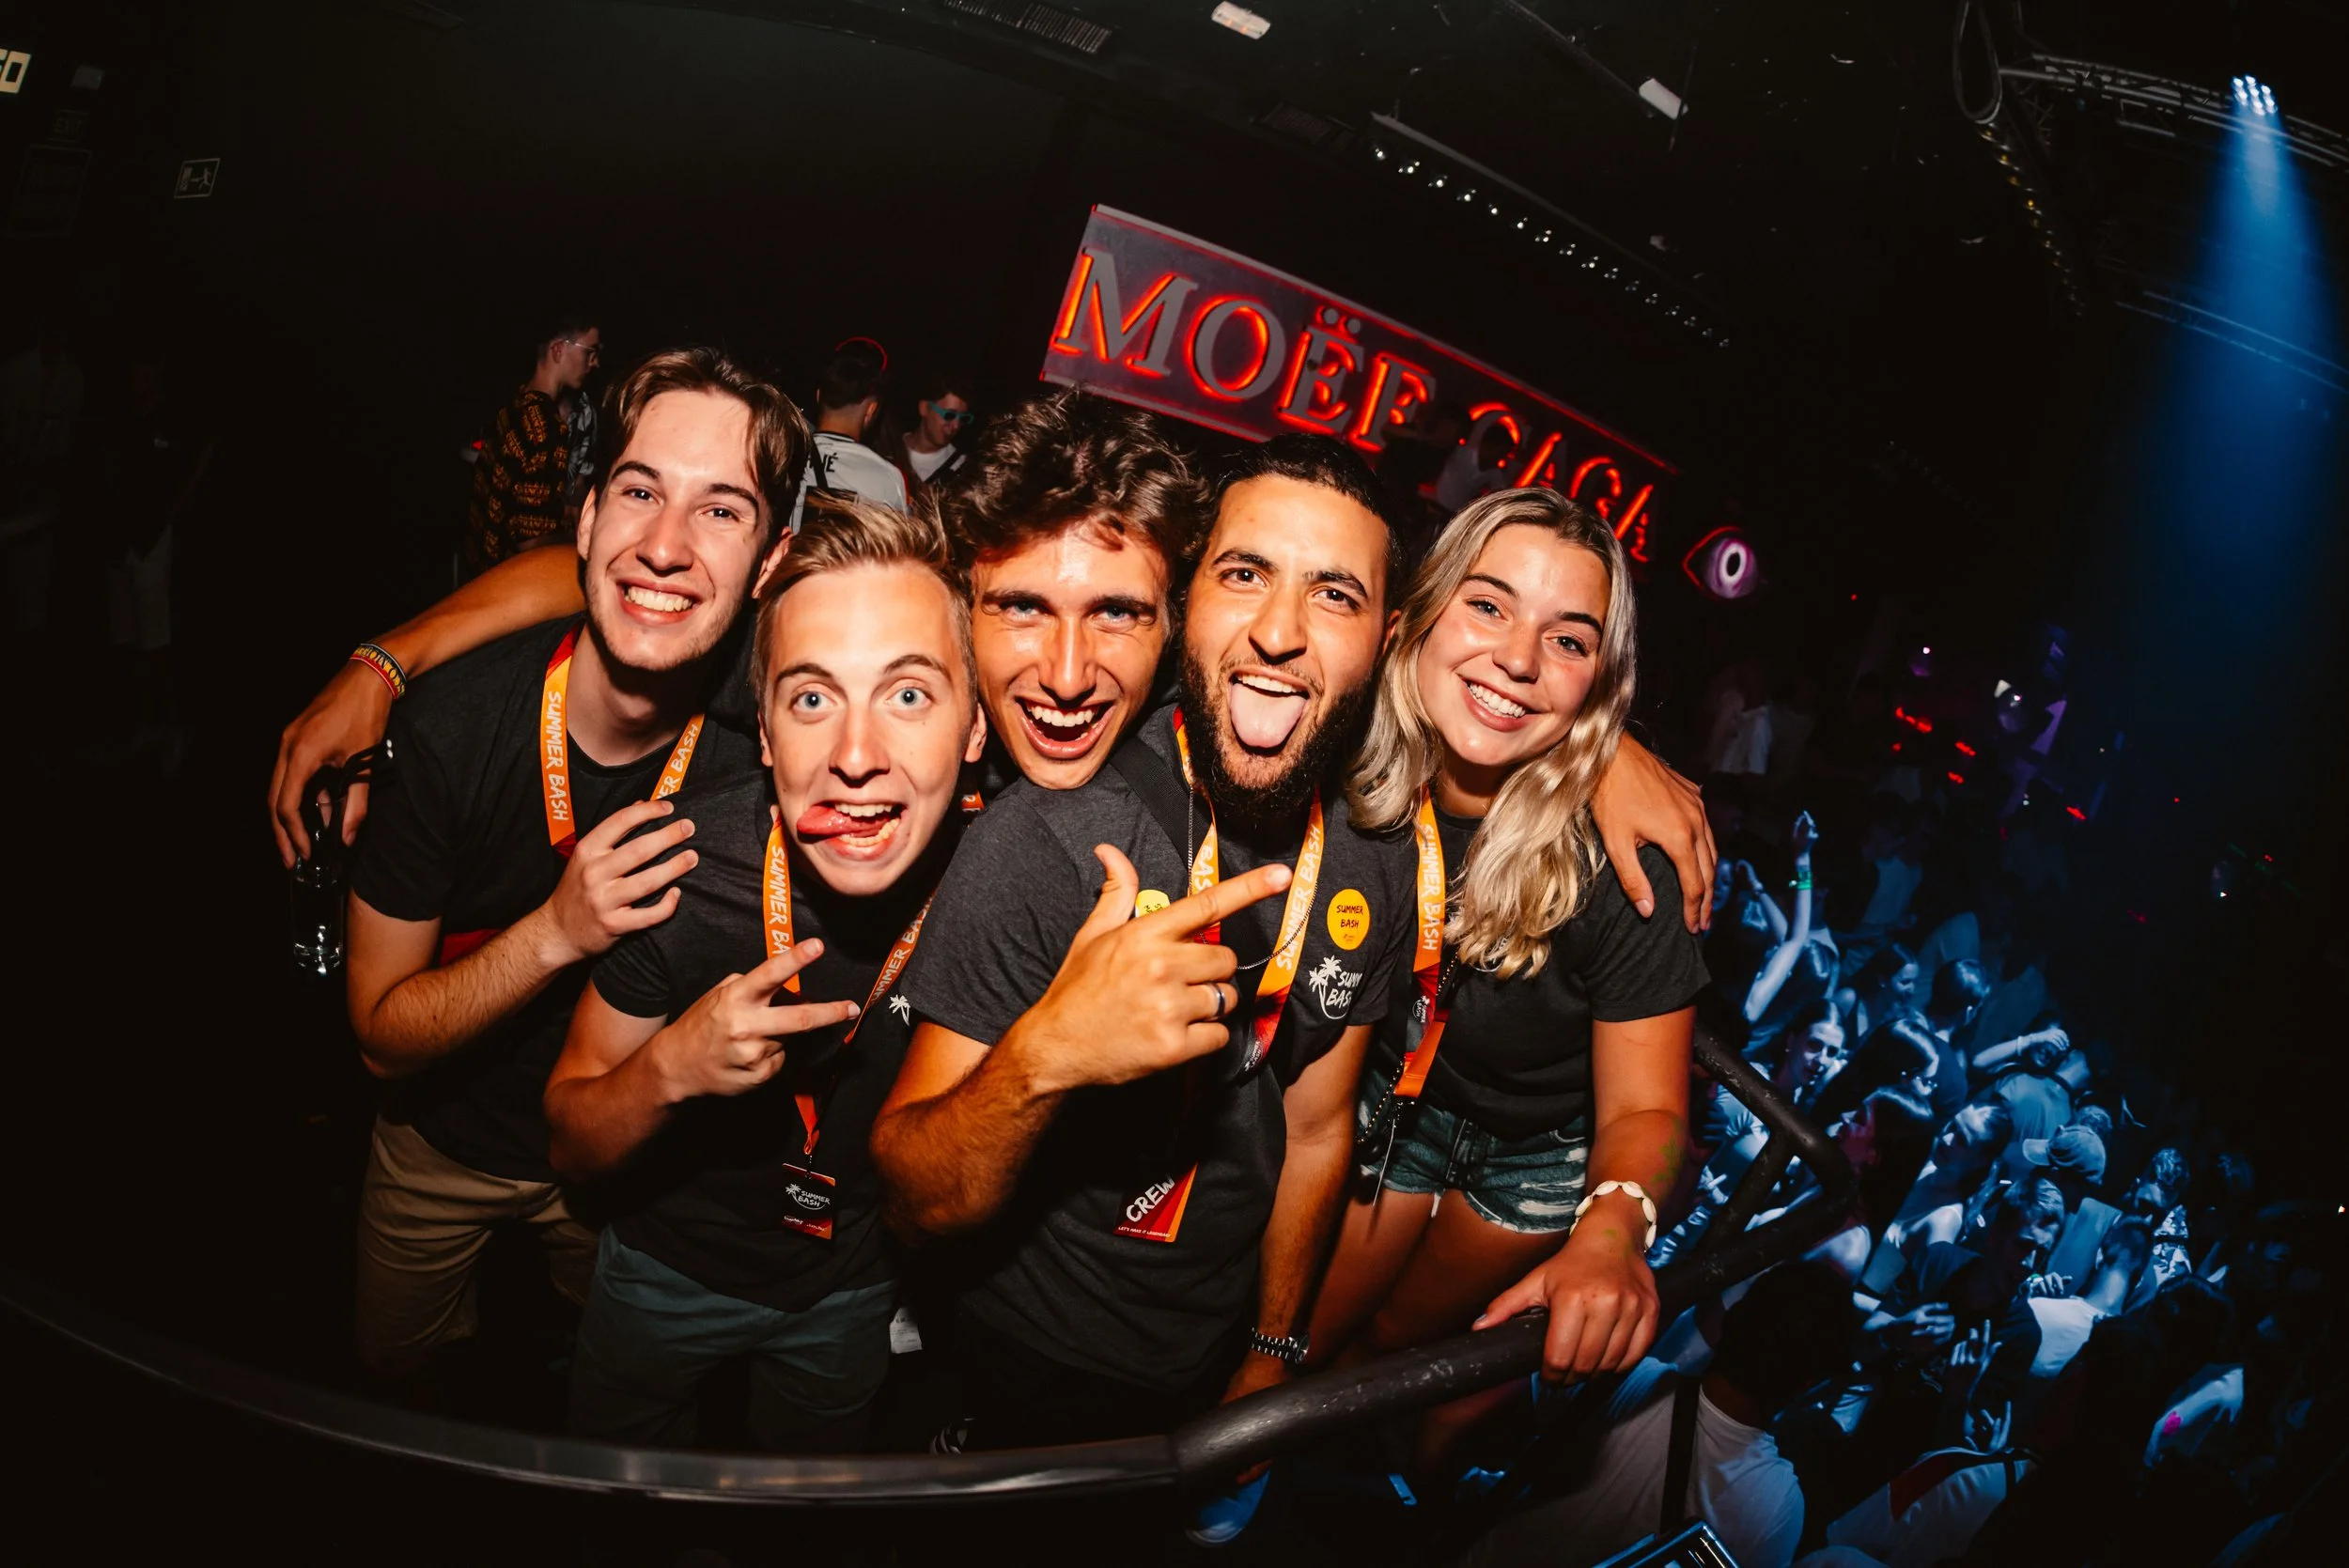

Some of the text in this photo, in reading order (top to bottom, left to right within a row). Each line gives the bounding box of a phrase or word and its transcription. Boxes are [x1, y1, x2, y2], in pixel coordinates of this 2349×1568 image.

[1050, 247, 1437, 452] MOËF
[546, 691, 568, 821] SUMMER BASH
[670, 724, 698, 772] BASH
[769, 845, 787, 925] SUMMER
[1276, 824, 1321, 970] SUMMER BASH
[1336, 905, 1363, 914] SUMMER
[1421, 823, 1440, 951] SUMMER BASH
[1340, 919, 1359, 928] BASH
[798, 1195, 820, 1207] BASH
[801, 1190, 831, 1205] SUMMER
[1126, 1173, 1175, 1222] CREW
